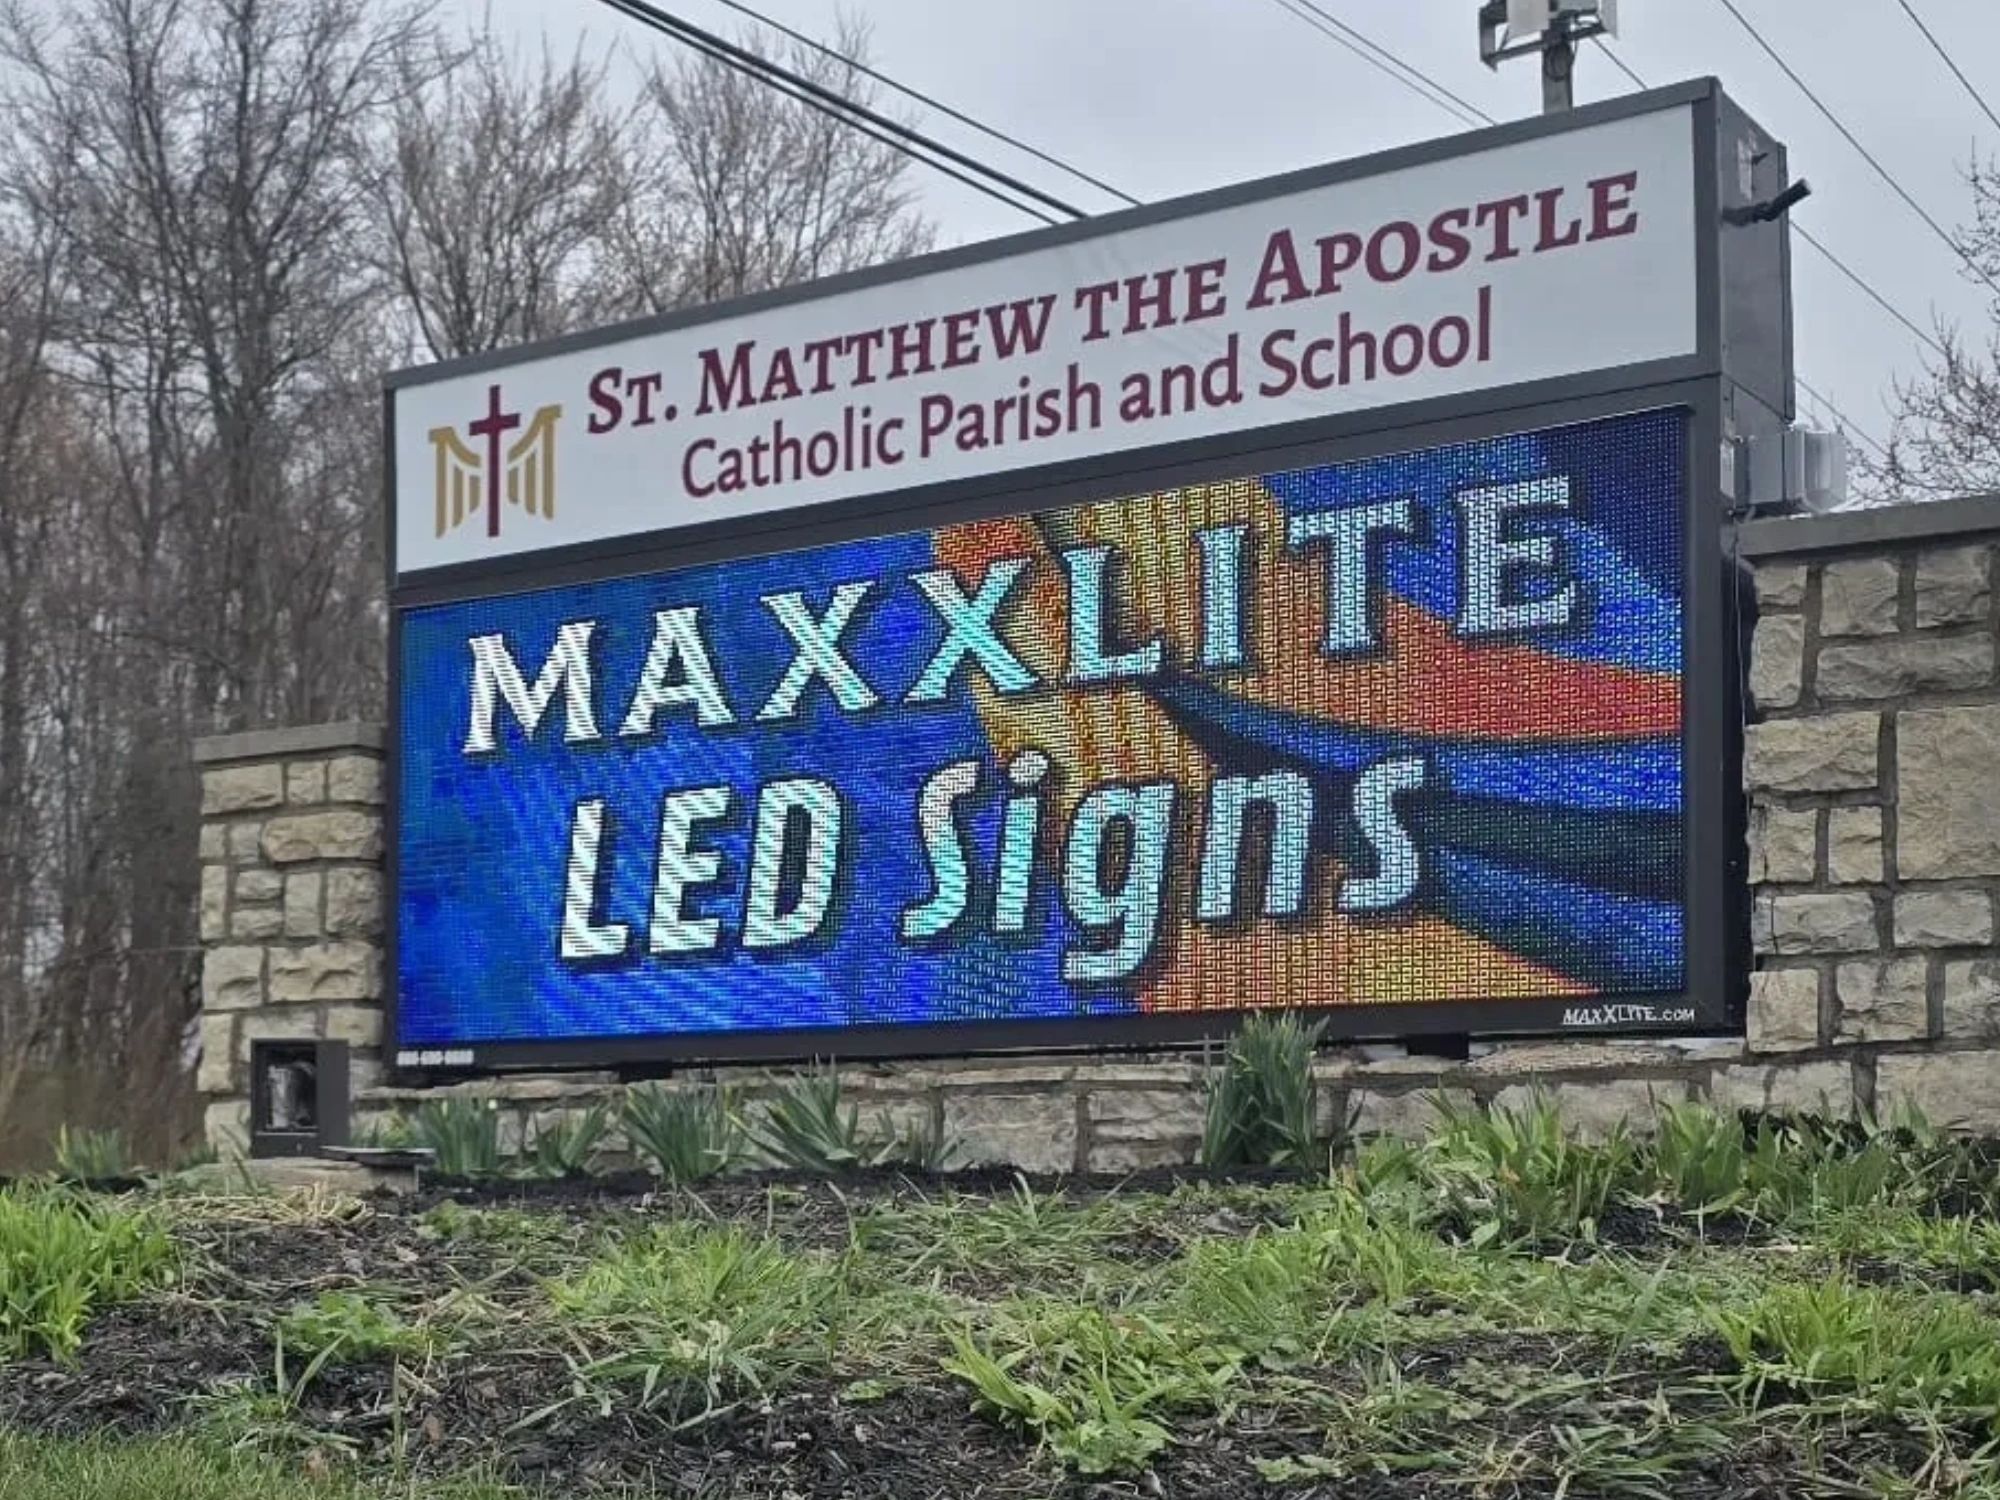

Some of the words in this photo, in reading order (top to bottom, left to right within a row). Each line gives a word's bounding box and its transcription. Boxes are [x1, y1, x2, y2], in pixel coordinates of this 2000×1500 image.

[587, 367, 677, 434] ST.
[695, 293, 1057, 416] MATTHEW
[1075, 258, 1227, 340] THE
[1246, 170, 1638, 310] APOSTLE
[682, 405, 904, 498] Catholic
[920, 362, 1101, 459] Parish
[1119, 333, 1243, 422] and
[1259, 286, 1492, 398] School
[461, 474, 1577, 755] MAXXLITE
[559, 777, 842, 960] LED
[901, 749, 1427, 981] Signs
